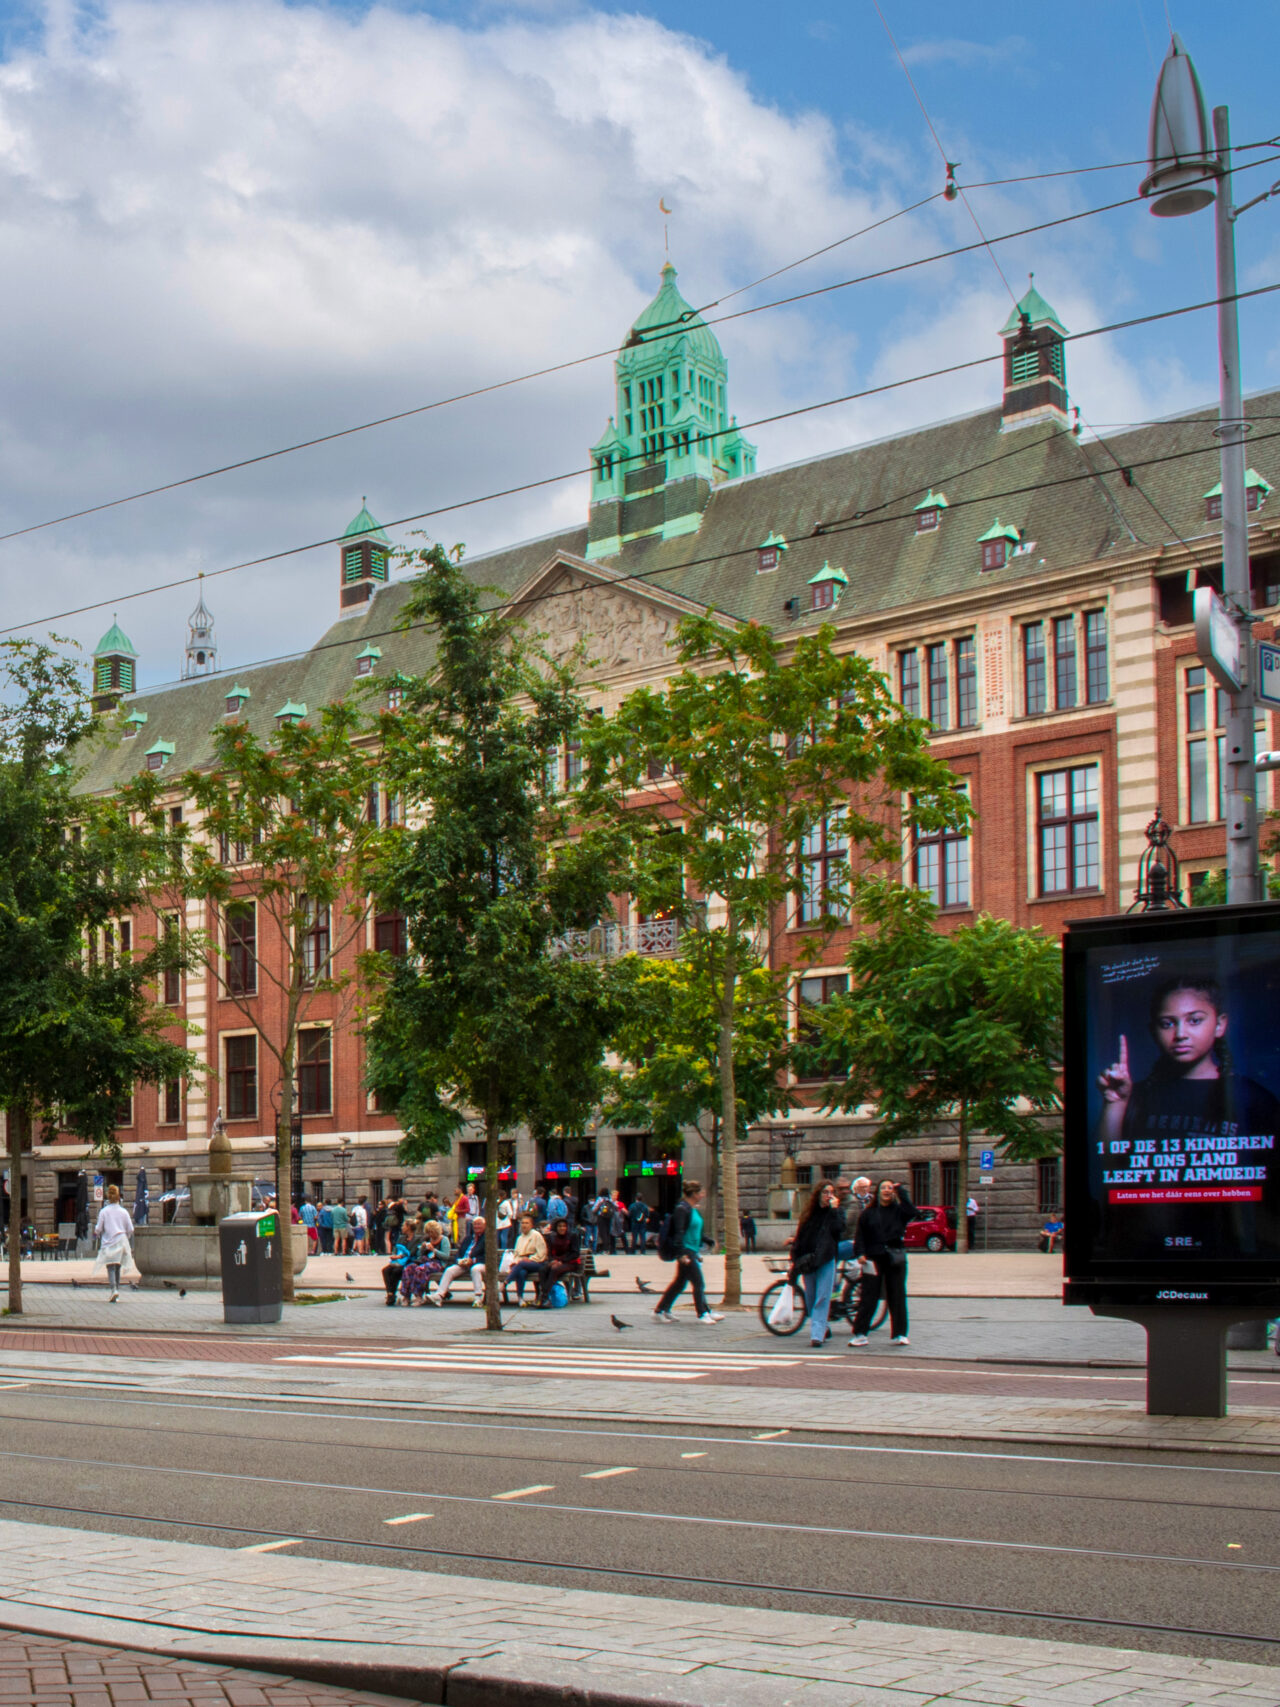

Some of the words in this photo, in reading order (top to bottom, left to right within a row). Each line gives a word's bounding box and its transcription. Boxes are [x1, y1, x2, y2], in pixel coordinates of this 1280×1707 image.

[1097, 1141, 1105, 1154] 1
[1110, 1140, 1131, 1154] OP
[1134, 1139, 1156, 1153] DE
[1161, 1139, 1181, 1152] 13
[1184, 1135, 1275, 1151] KINDEREN
[1130, 1154, 1149, 1168] IN
[1153, 1154, 1186, 1168] ONS
[1190, 1152, 1238, 1166] LAND
[1103, 1169, 1156, 1183] LEEFT
[1159, 1168, 1180, 1182] IN
[1183, 1166, 1267, 1182] ARMOEDE
[1156, 1290, 1209, 1299] JCDecaux
